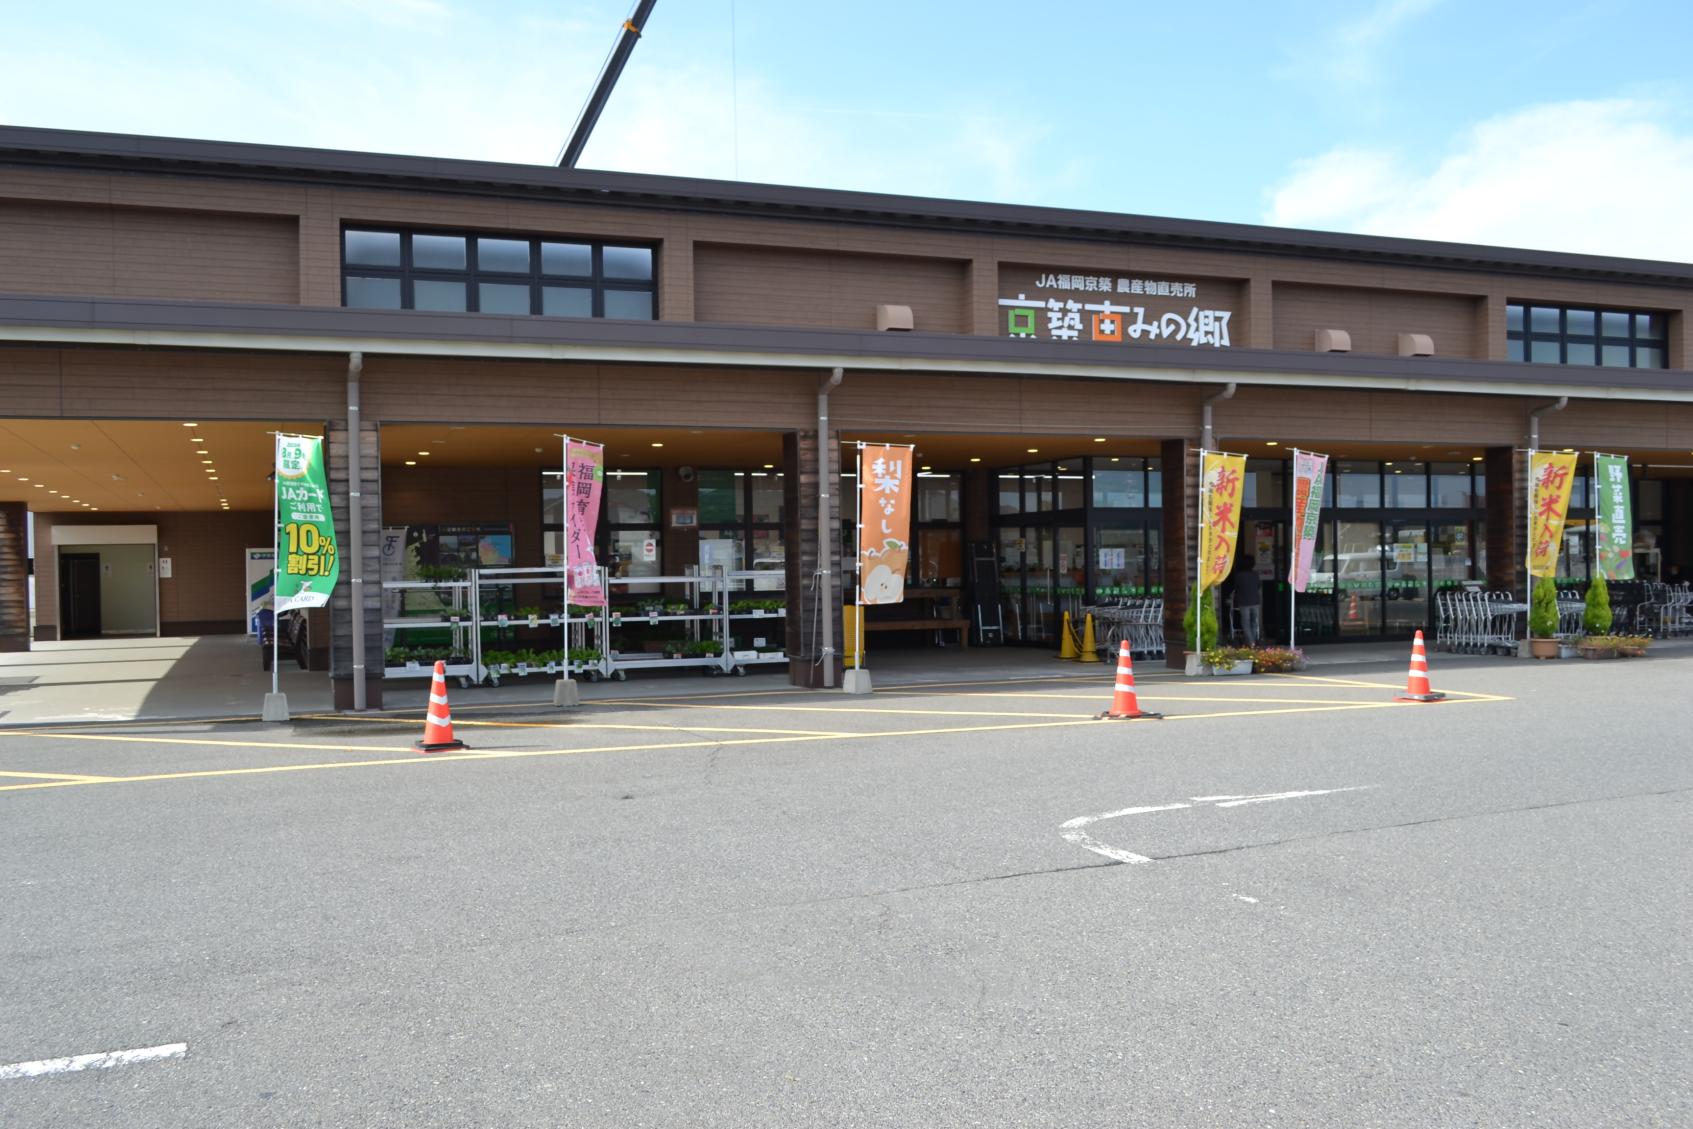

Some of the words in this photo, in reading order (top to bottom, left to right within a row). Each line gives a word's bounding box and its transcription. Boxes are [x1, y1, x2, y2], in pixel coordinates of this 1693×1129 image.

[1035, 273, 1112, 292] JA福岡京築
[1117, 278, 1197, 298] 農産物直売所
[872, 457, 902, 534] 梨なし
[1212, 465, 1239, 574] 新米入荷
[1608, 464, 1626, 544] 野菜直売
[285, 523, 335, 554] 10%
